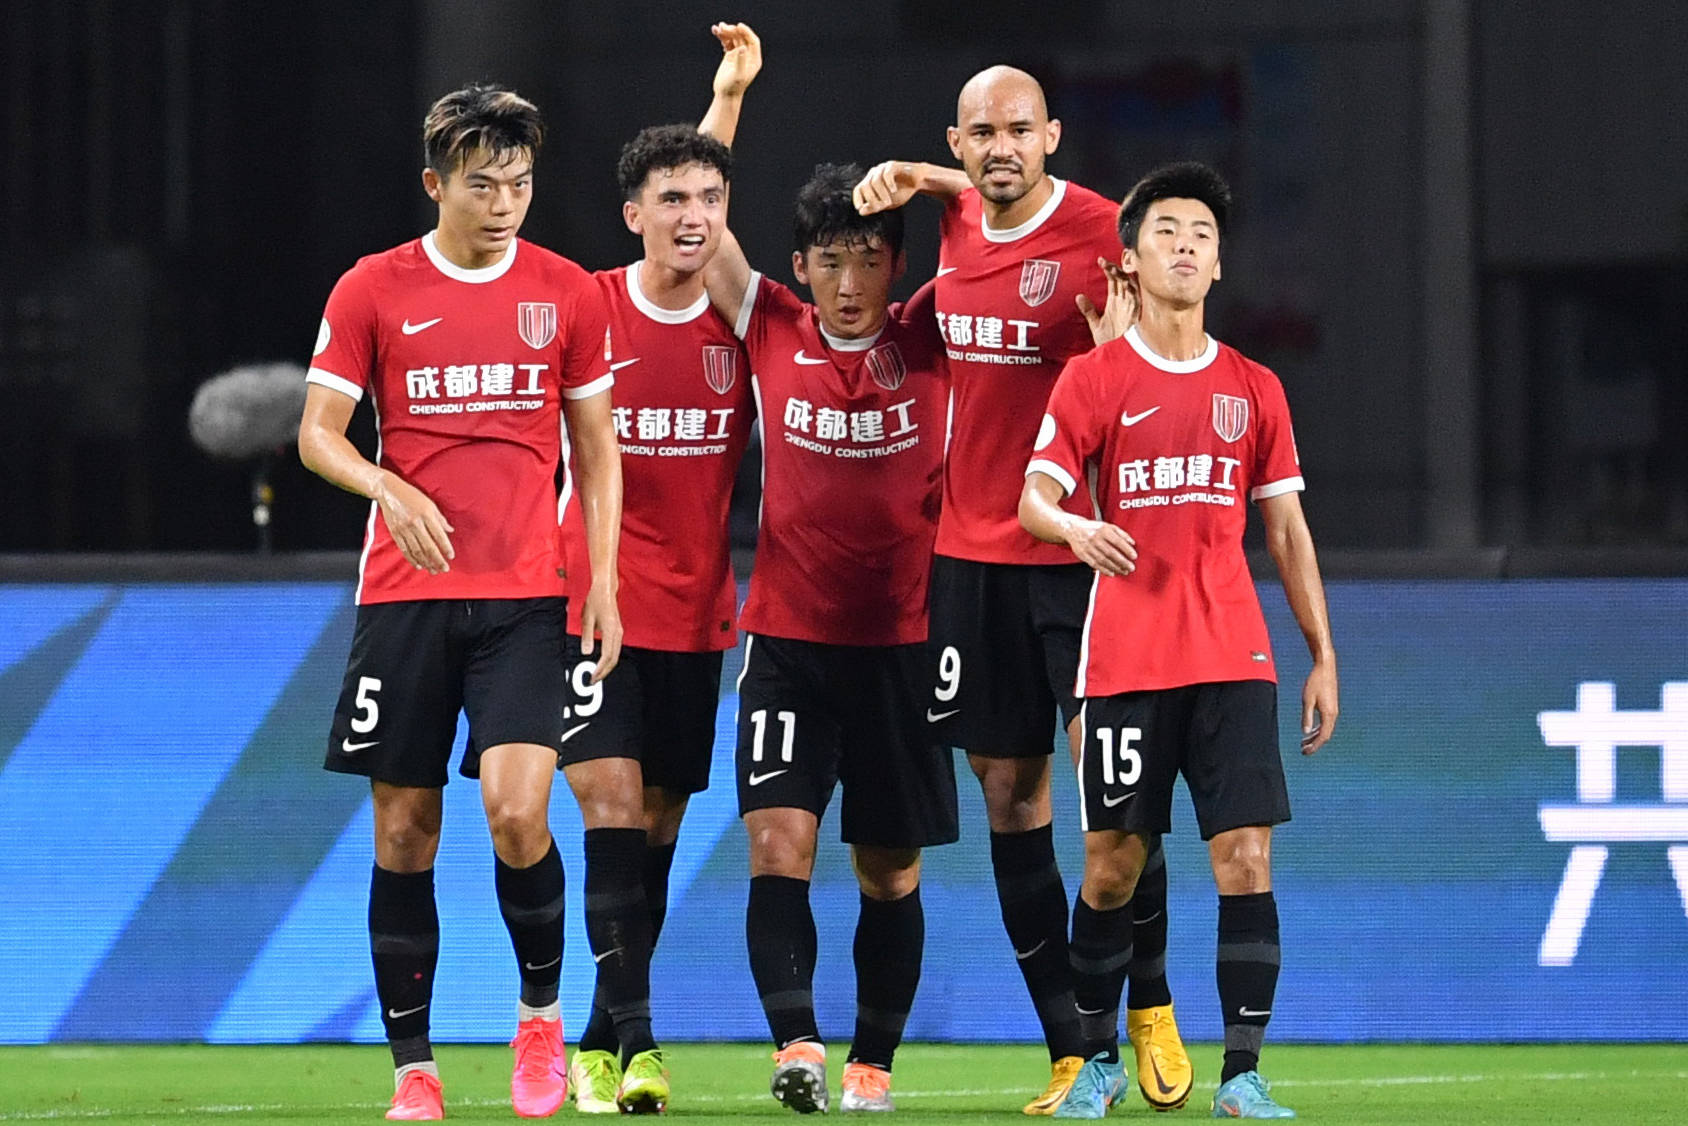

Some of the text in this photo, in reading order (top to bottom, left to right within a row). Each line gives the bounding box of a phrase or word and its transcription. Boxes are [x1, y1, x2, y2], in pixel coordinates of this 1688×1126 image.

[965, 351, 1042, 365] CONSTRUCTION
[406, 363, 549, 399] 成都建工
[409, 399, 544, 416] CHENGDU CONSTRUCTION
[783, 397, 919, 443] 成都建工
[618, 443, 656, 456] NGDU
[834, 435, 919, 458] CONSTRUCTION
[1118, 453, 1241, 493] 成都建工
[1119, 495, 1170, 510] CHENGDU
[934, 645, 961, 701] 9
[350, 676, 382, 733] 5
[750, 709, 796, 763] 11
[1096, 727, 1143, 786] 15
[1537, 681, 1688, 967] 共
